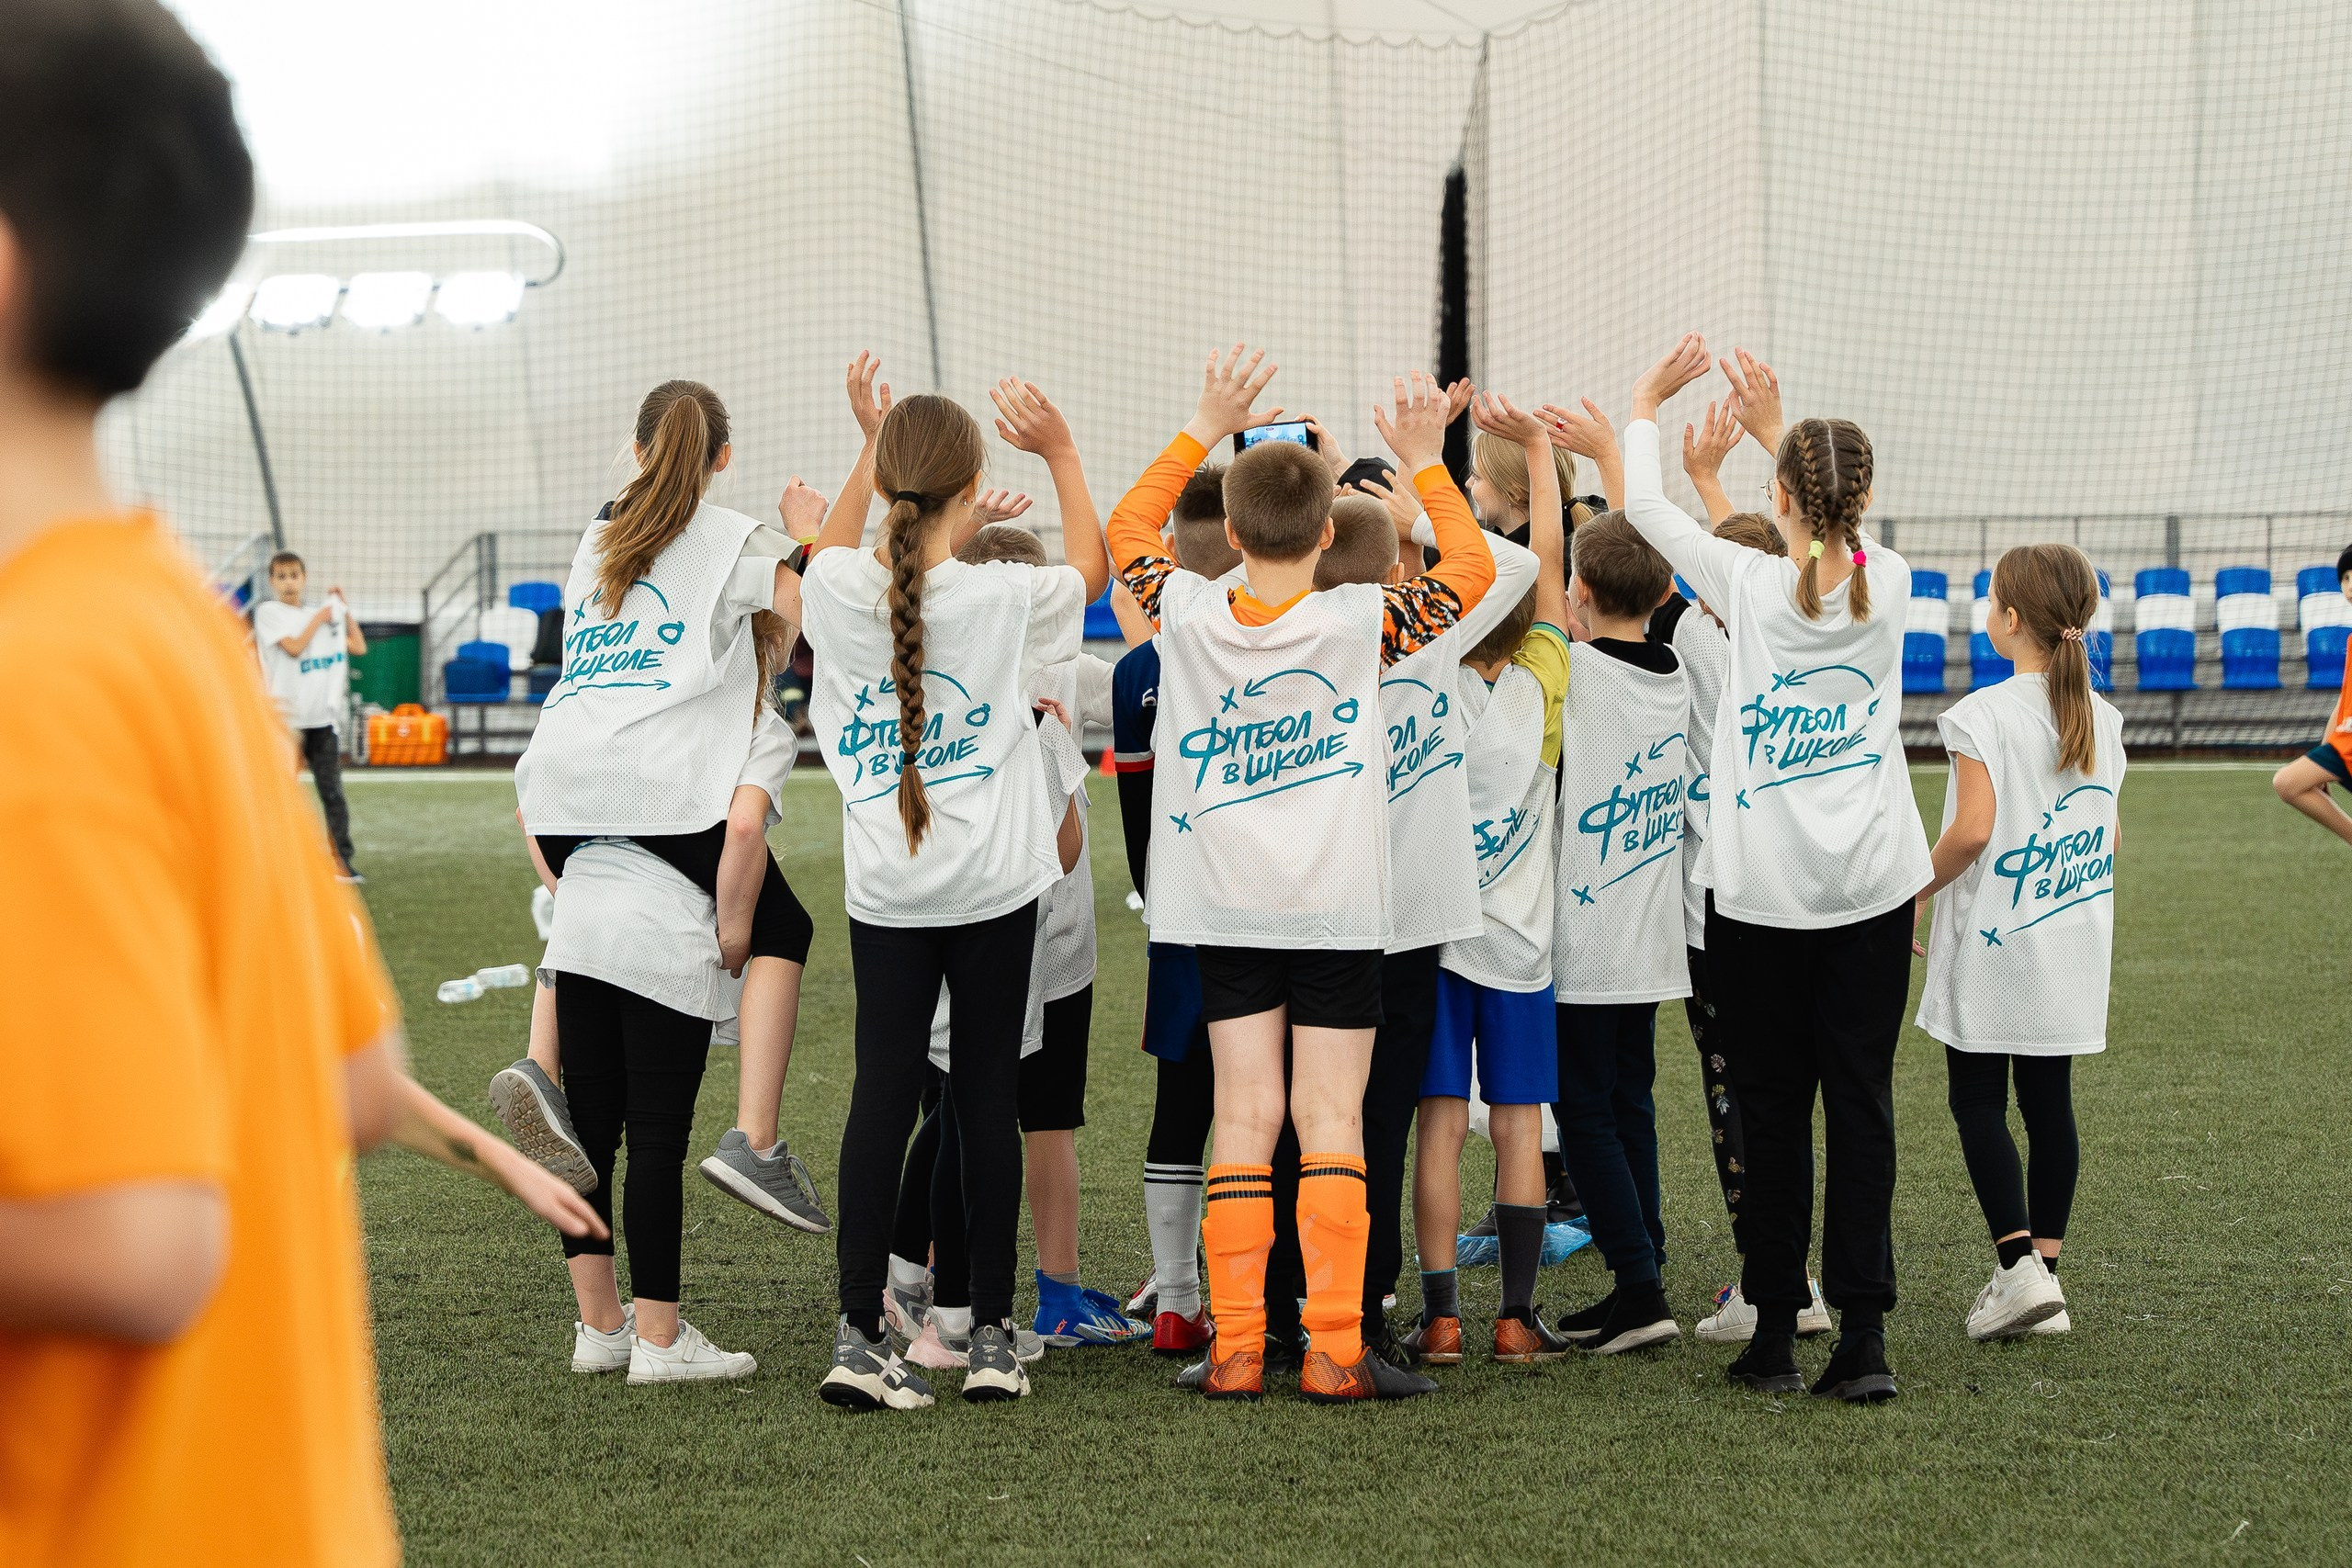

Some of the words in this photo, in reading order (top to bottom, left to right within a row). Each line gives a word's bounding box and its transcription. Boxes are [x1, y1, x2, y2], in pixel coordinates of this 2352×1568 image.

[564, 620, 639, 657] УТБОЛ
[1180, 710, 1312, 794] ФУТБОЛ
[1222, 762, 1240, 784] В
[1244, 732, 1349, 785] ШКОЛЕ
[1386, 726, 1445, 791] КОЛЕ
[1740, 694, 1847, 770] ФУТБОЛ
[869, 754, 889, 776] В
[1578, 774, 1683, 865] ФУТБОЛ
[1623, 829, 1639, 852] В
[1994, 826, 2105, 909] ФУТБОЛ
[2034, 878, 2052, 899] В
[2053, 853, 2113, 899] ШКОЛ
